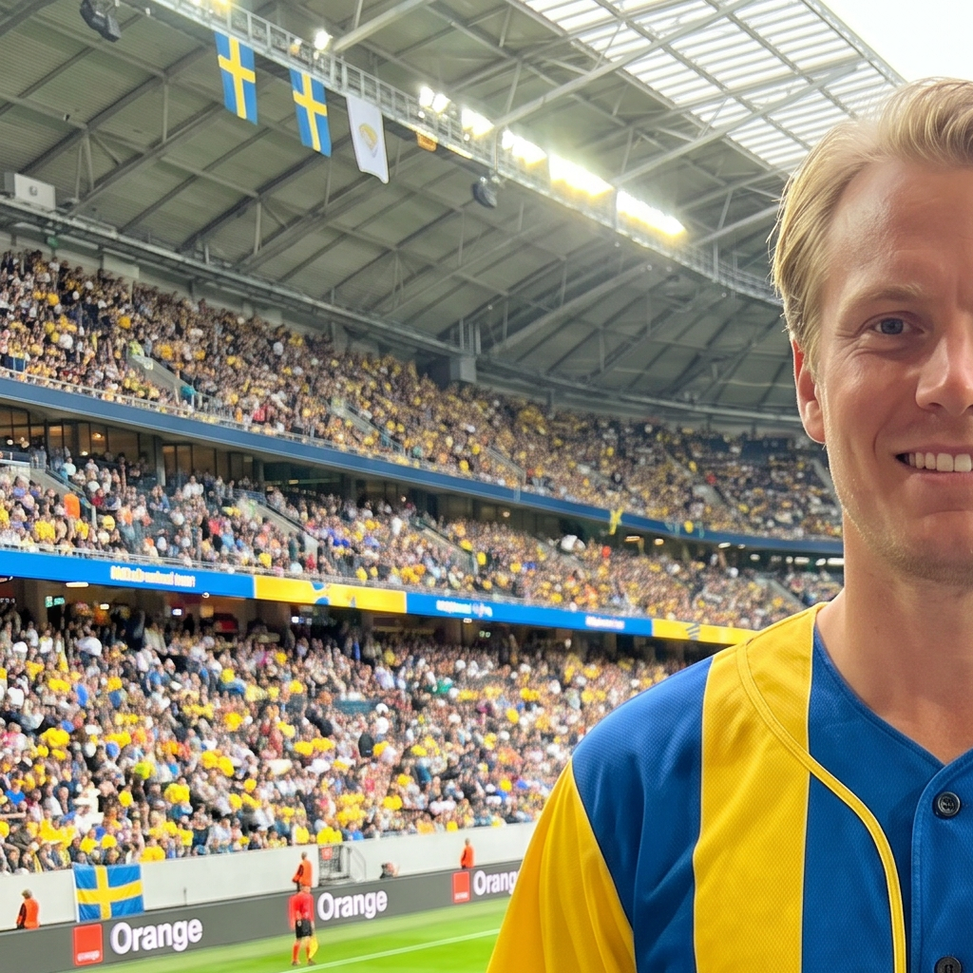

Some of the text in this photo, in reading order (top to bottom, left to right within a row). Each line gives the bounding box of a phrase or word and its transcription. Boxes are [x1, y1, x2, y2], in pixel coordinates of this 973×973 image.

[473, 870, 518, 896] Orang
[317, 891, 388, 920] Orange
[110, 918, 203, 954] Orange
